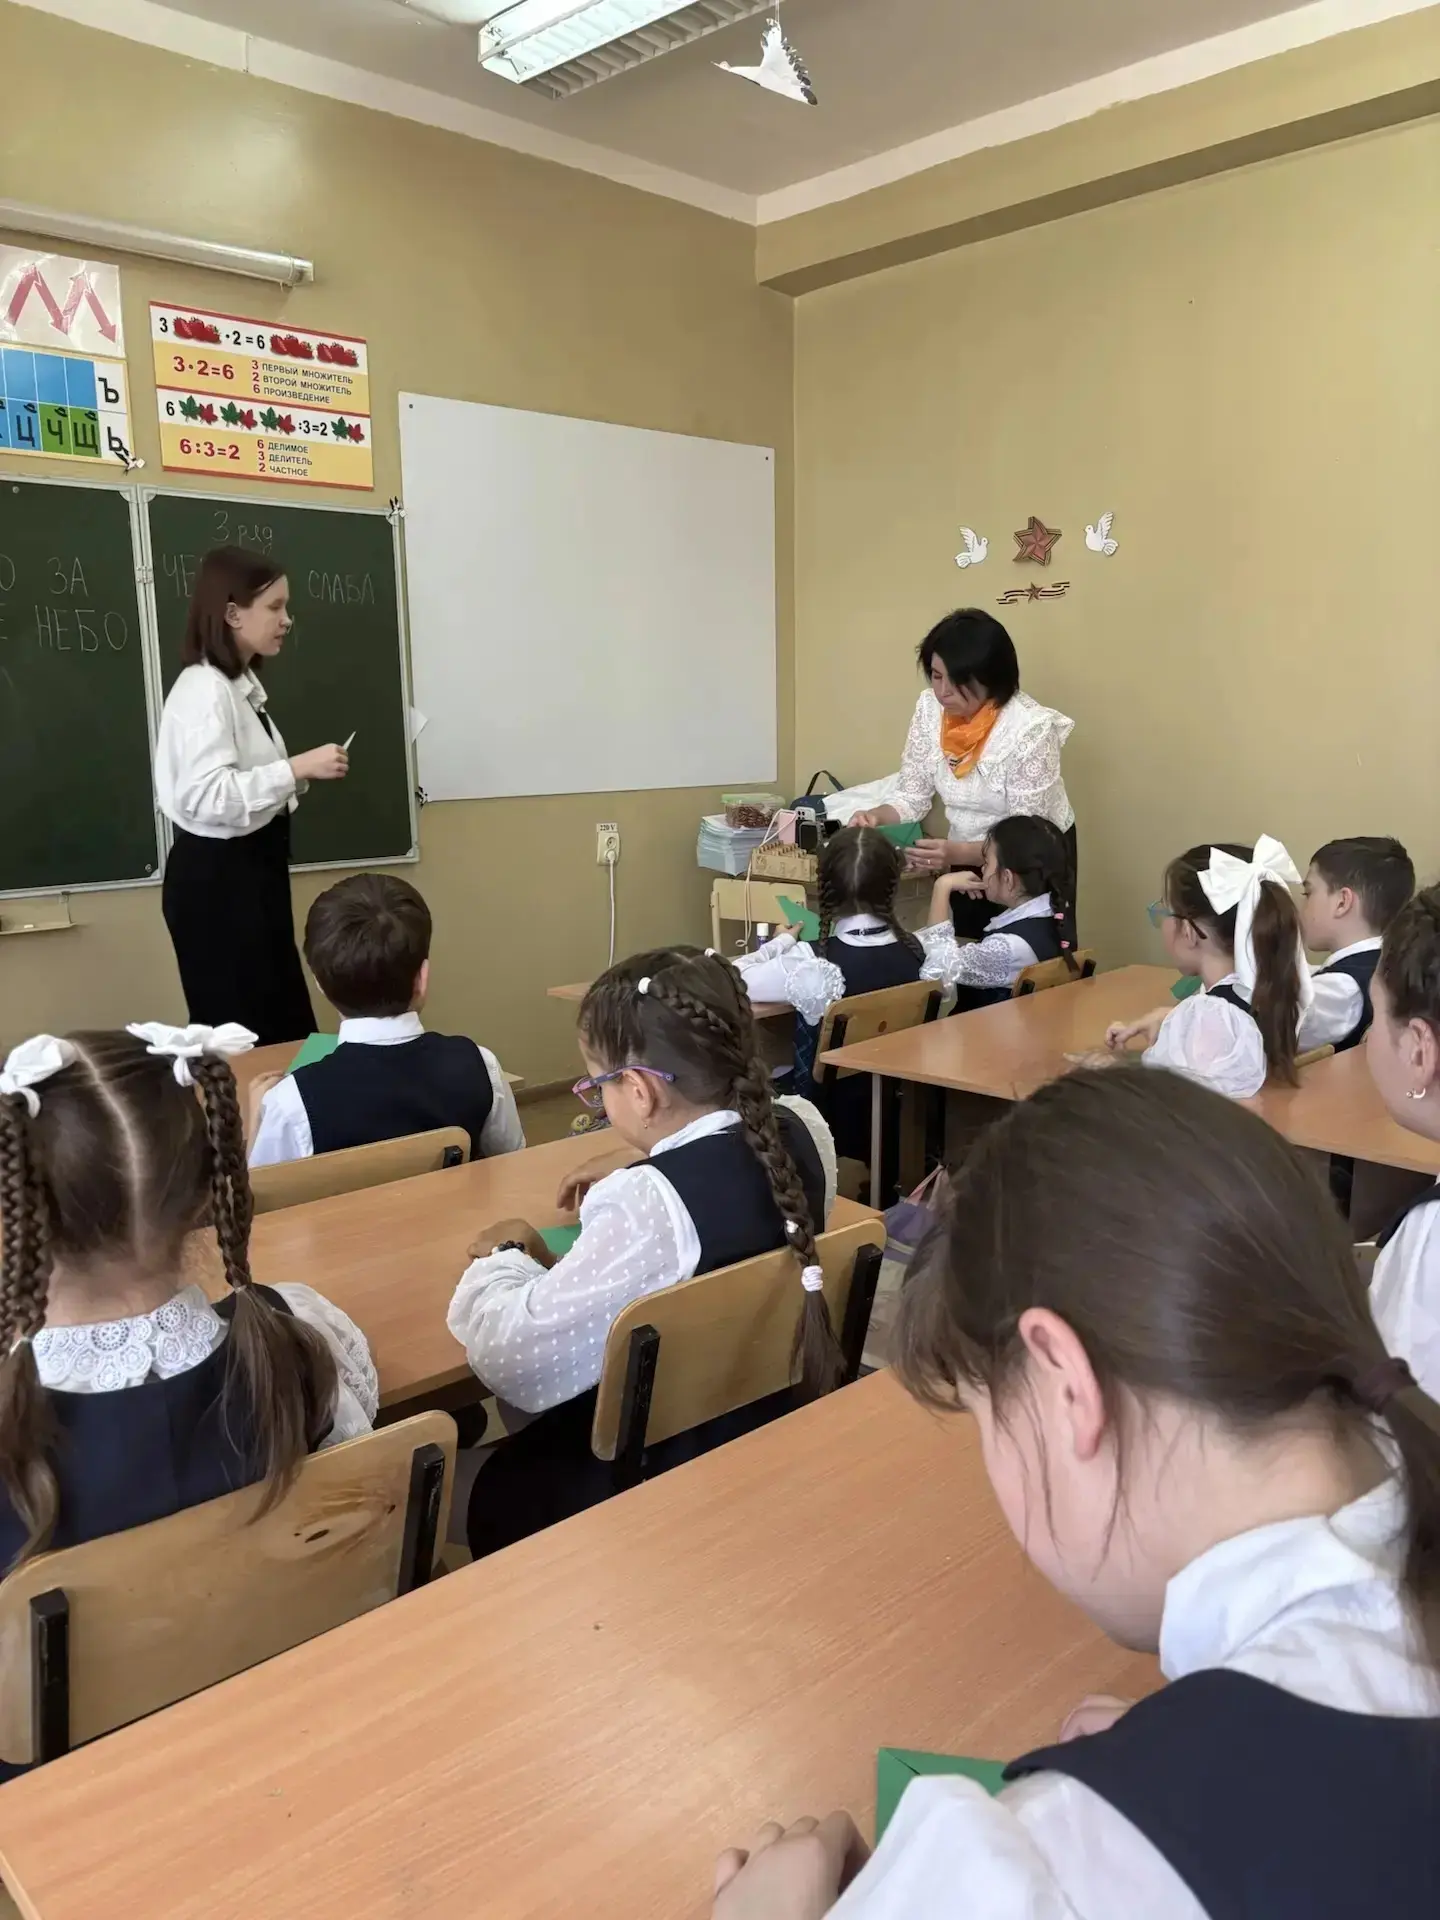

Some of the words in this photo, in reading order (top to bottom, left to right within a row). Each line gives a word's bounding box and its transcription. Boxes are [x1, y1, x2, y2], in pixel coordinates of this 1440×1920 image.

[159, 317, 168, 333] 3
[252, 360, 259, 370] 3
[262, 363, 299, 376] ПЕРВЫЙ
[301, 369, 354, 384] МНОЖИТЕЛЬ
[98, 377, 120, 404] Ъ
[252, 372, 260, 382] 2
[263, 375, 298, 387] ВТОРОЙ
[300, 381, 352, 395] МНОЖИТЕЛЬ
[253, 384, 261, 394] 6
[263, 386, 331, 404] ПРОИЗВЕДЕНИЕ
[166, 401, 175, 416] 6
[16, 415, 36, 448] Ц
[46, 418, 63, 445] Ч
[73, 422, 99, 454] Щ
[257, 439, 265, 449] 6
[268, 441, 309, 454] ДЕЛИМОЕ
[258, 451, 265, 461] 3
[269, 453, 313, 466] ДЕЛИТЕЛЬ
[258, 463, 266, 473] 2
[269, 465, 309, 477] ЧАСТНОЕ
[35, 604, 128, 652] НЕБО
